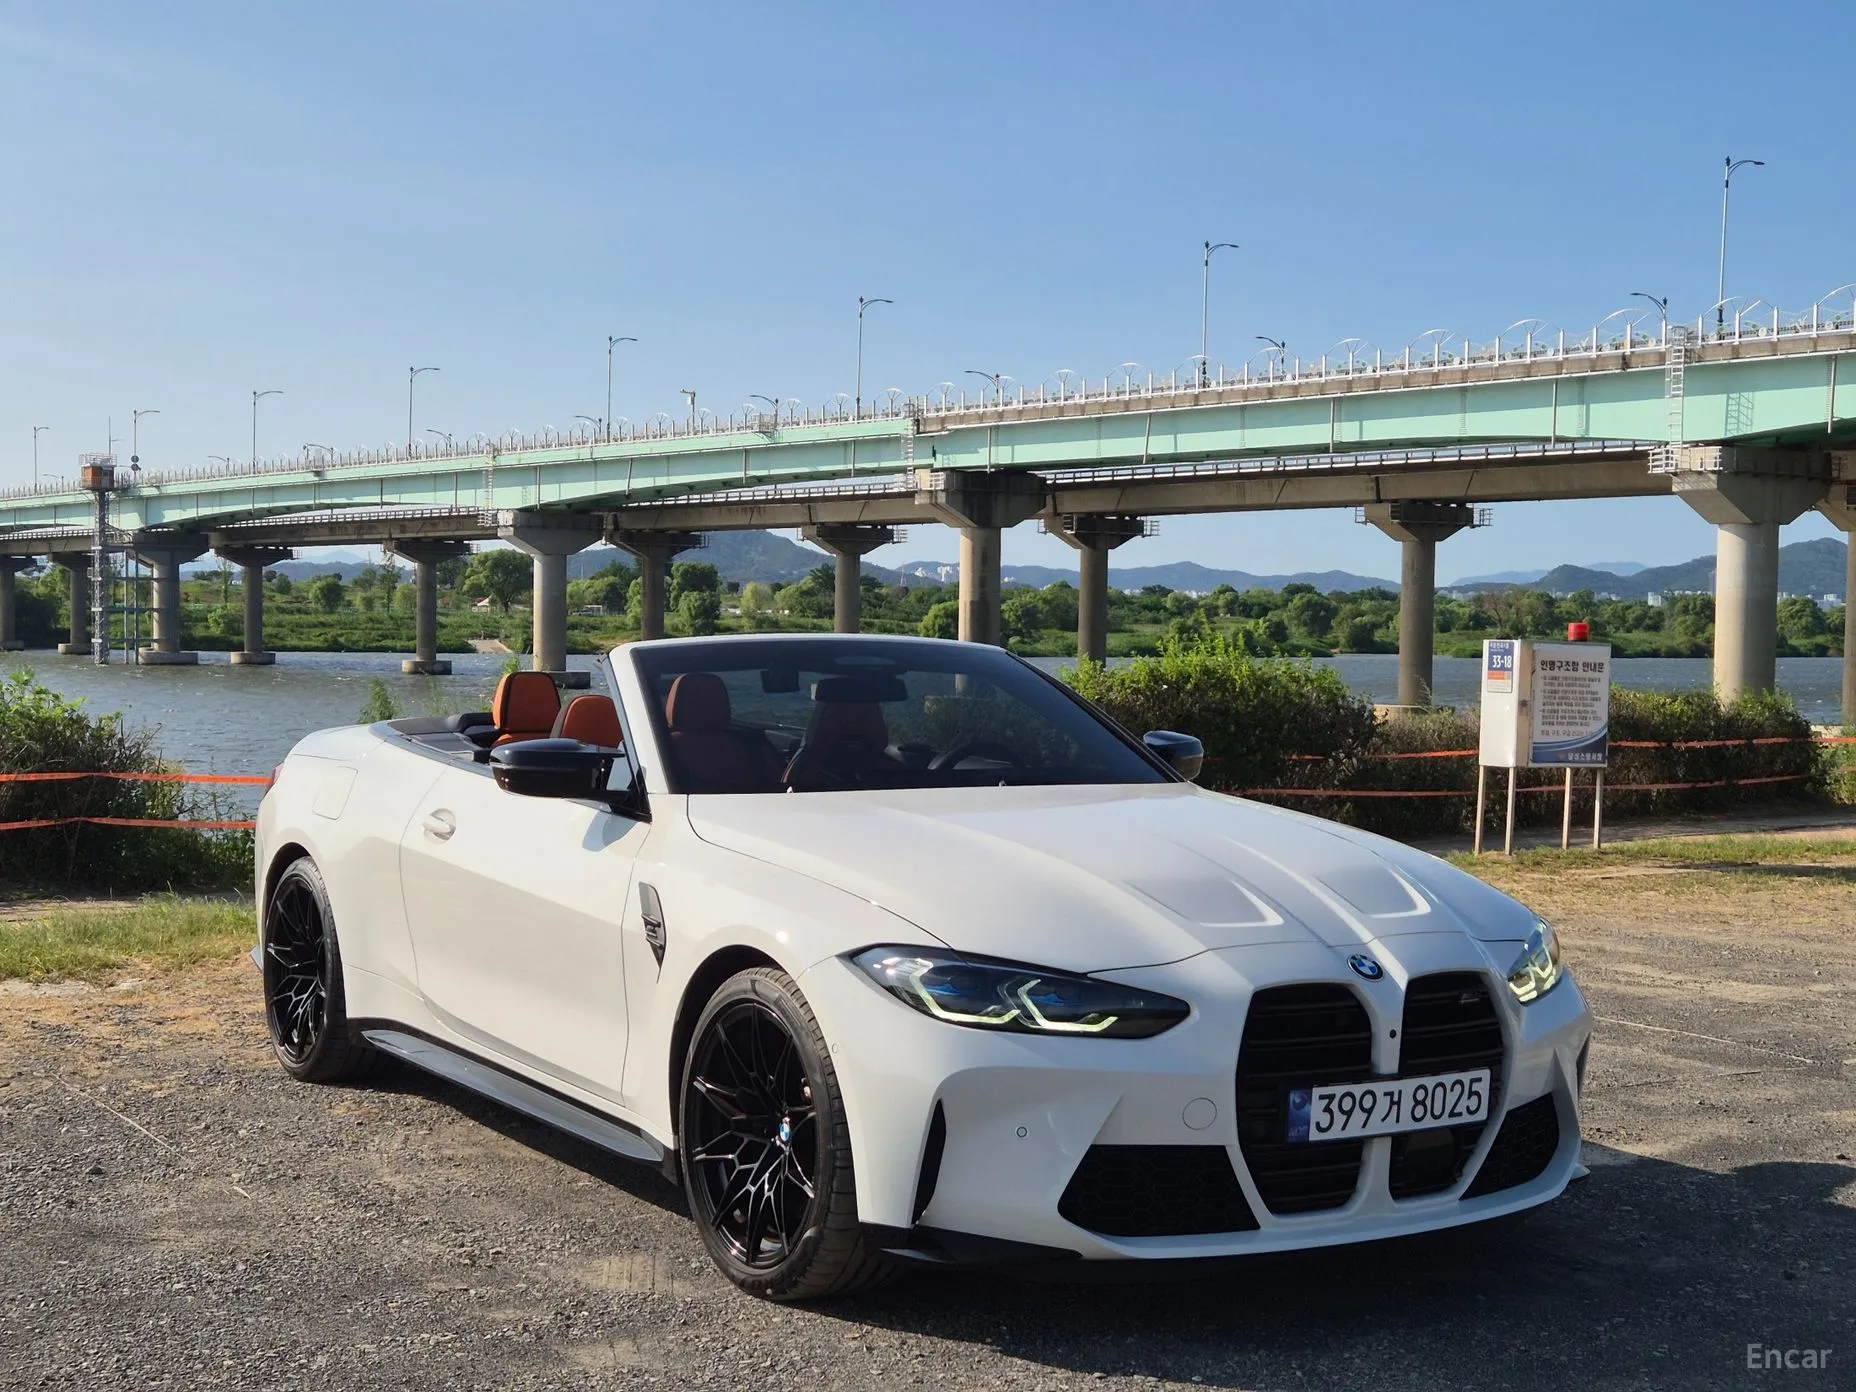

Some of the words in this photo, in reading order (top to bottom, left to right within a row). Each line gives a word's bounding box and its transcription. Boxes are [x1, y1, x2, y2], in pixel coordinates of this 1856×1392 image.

[1492, 655, 1512, 668] 33-18
[1540, 659, 1579, 672] 인명구조함
[1582, 662, 1605, 673] 안내문
[1315, 1089, 1402, 1133] 399거
[1410, 1077, 1483, 1123] 8025
